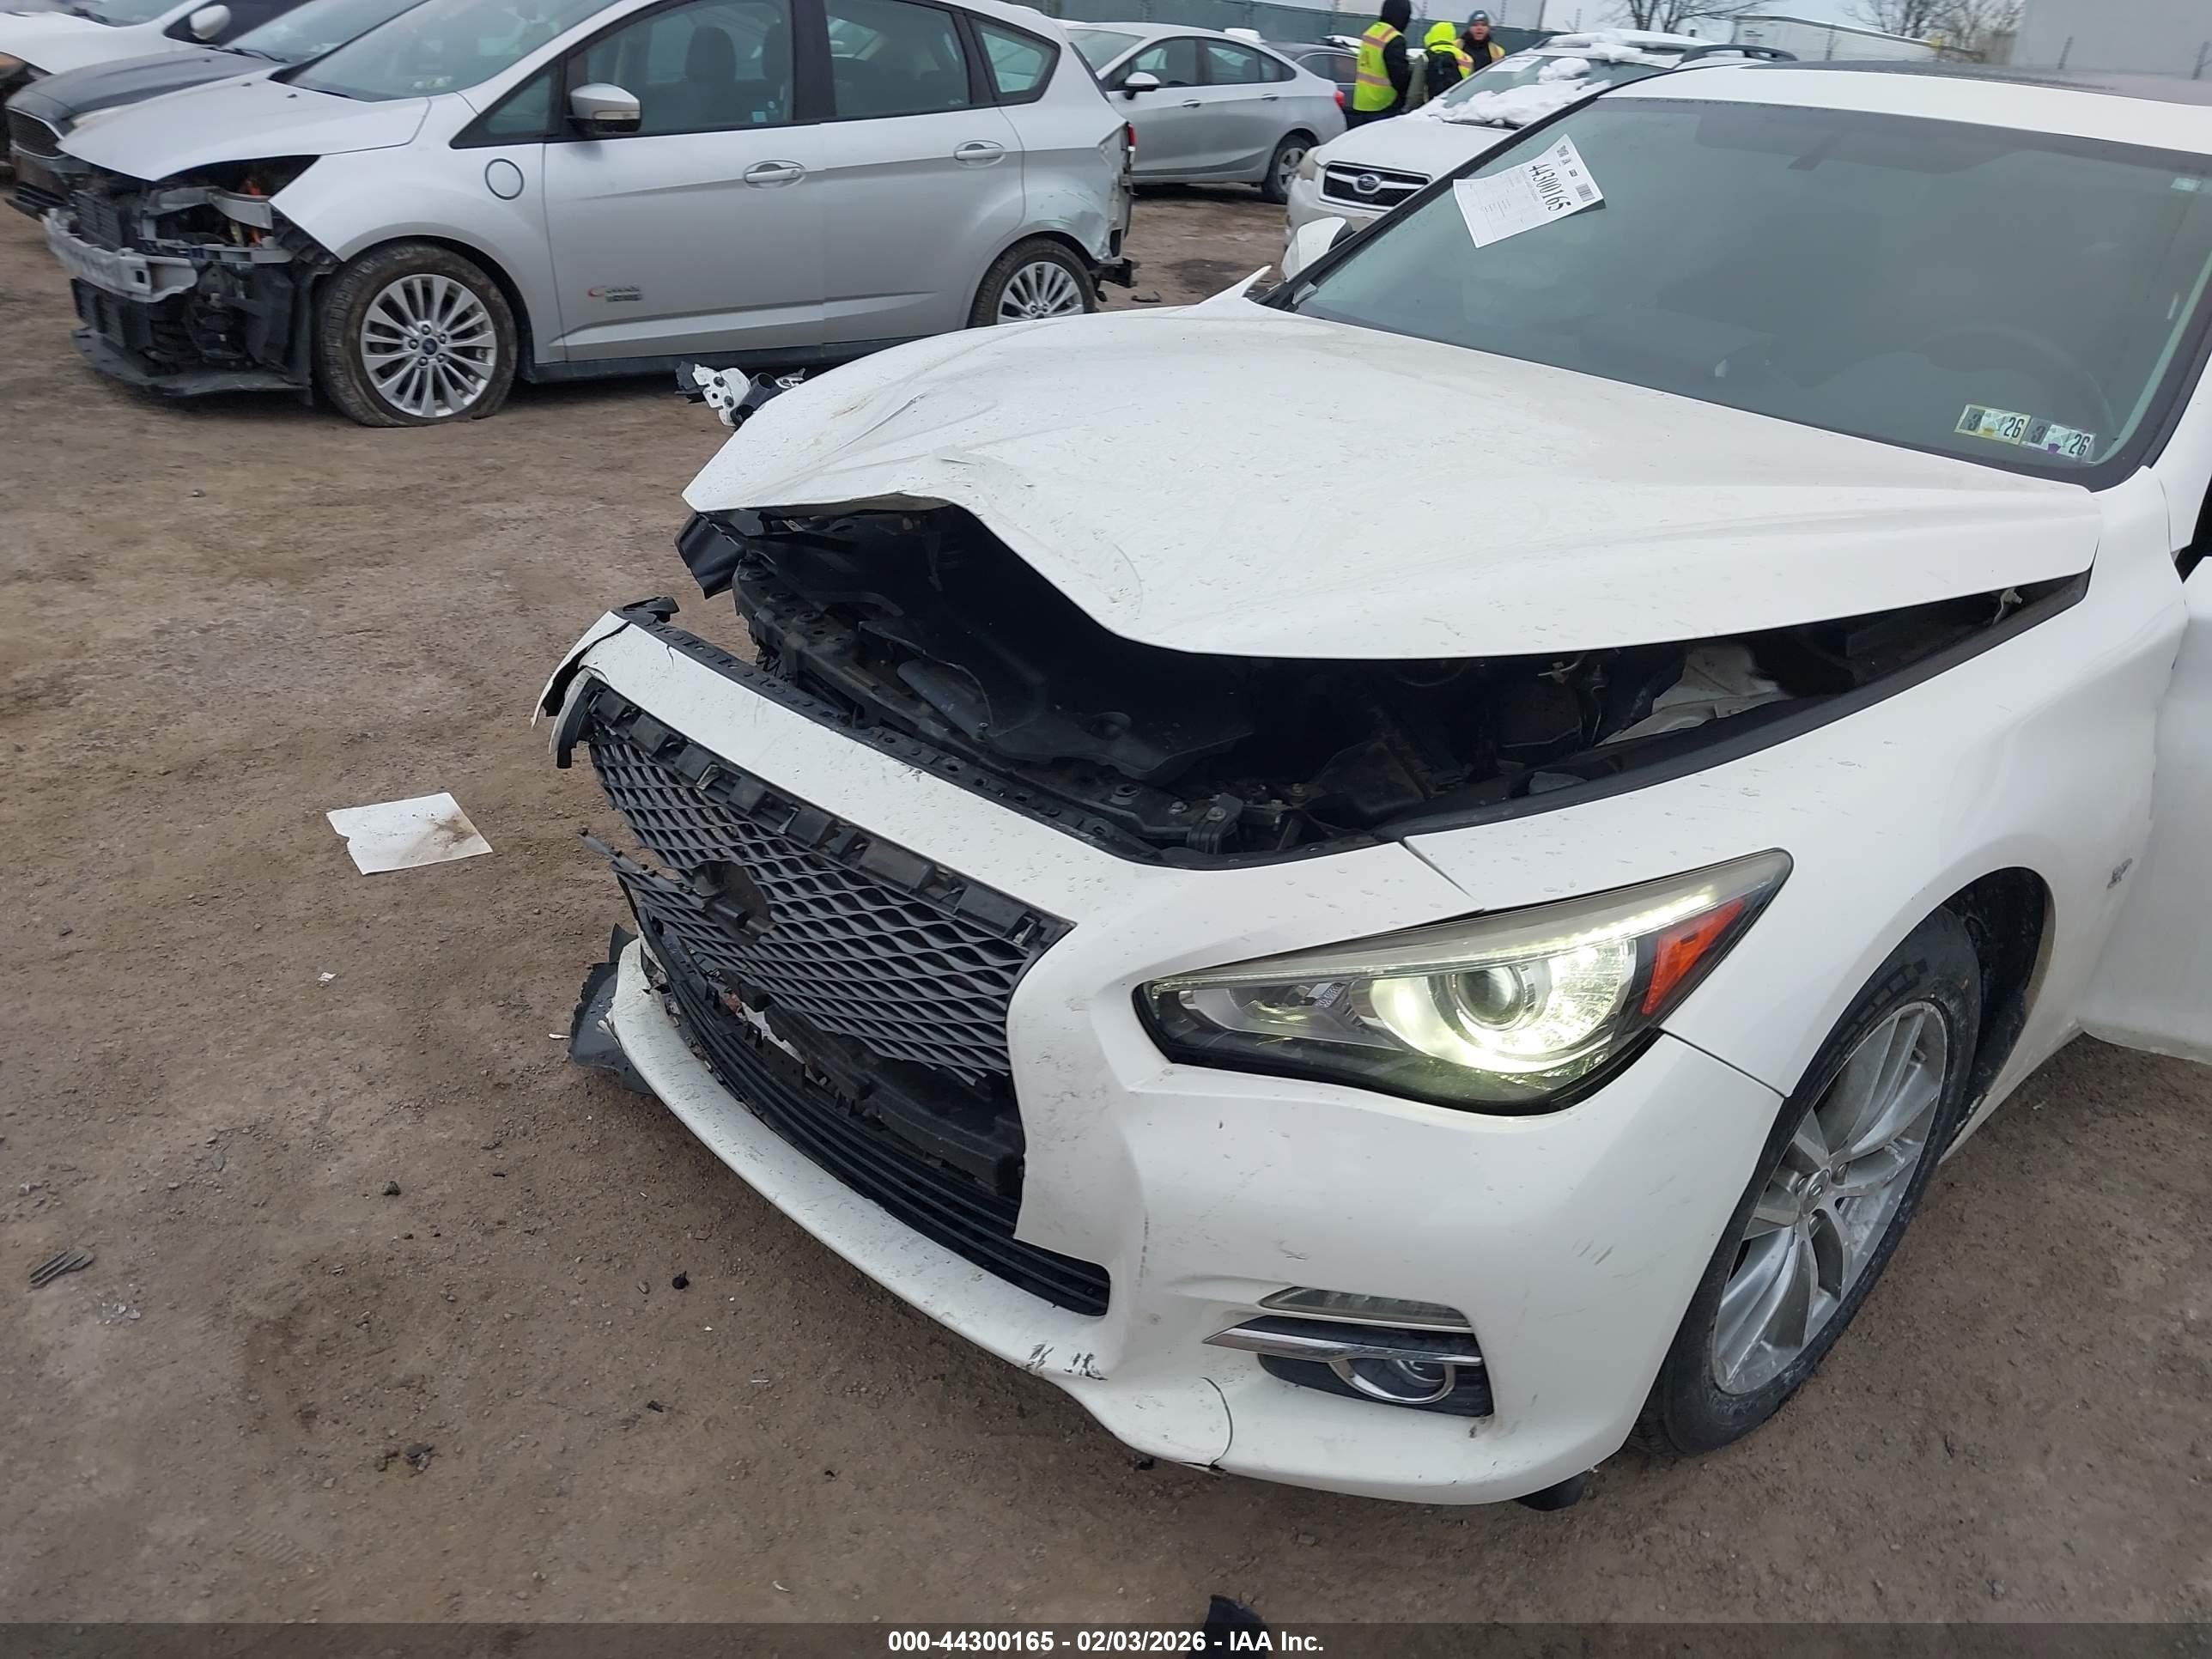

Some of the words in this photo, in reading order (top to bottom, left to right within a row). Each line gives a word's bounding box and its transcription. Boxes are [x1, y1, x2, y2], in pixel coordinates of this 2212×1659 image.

[1528, 163, 1571, 212] 44300165
[2003, 416, 2025, 438] 26
[2069, 434, 2091, 457] 26
